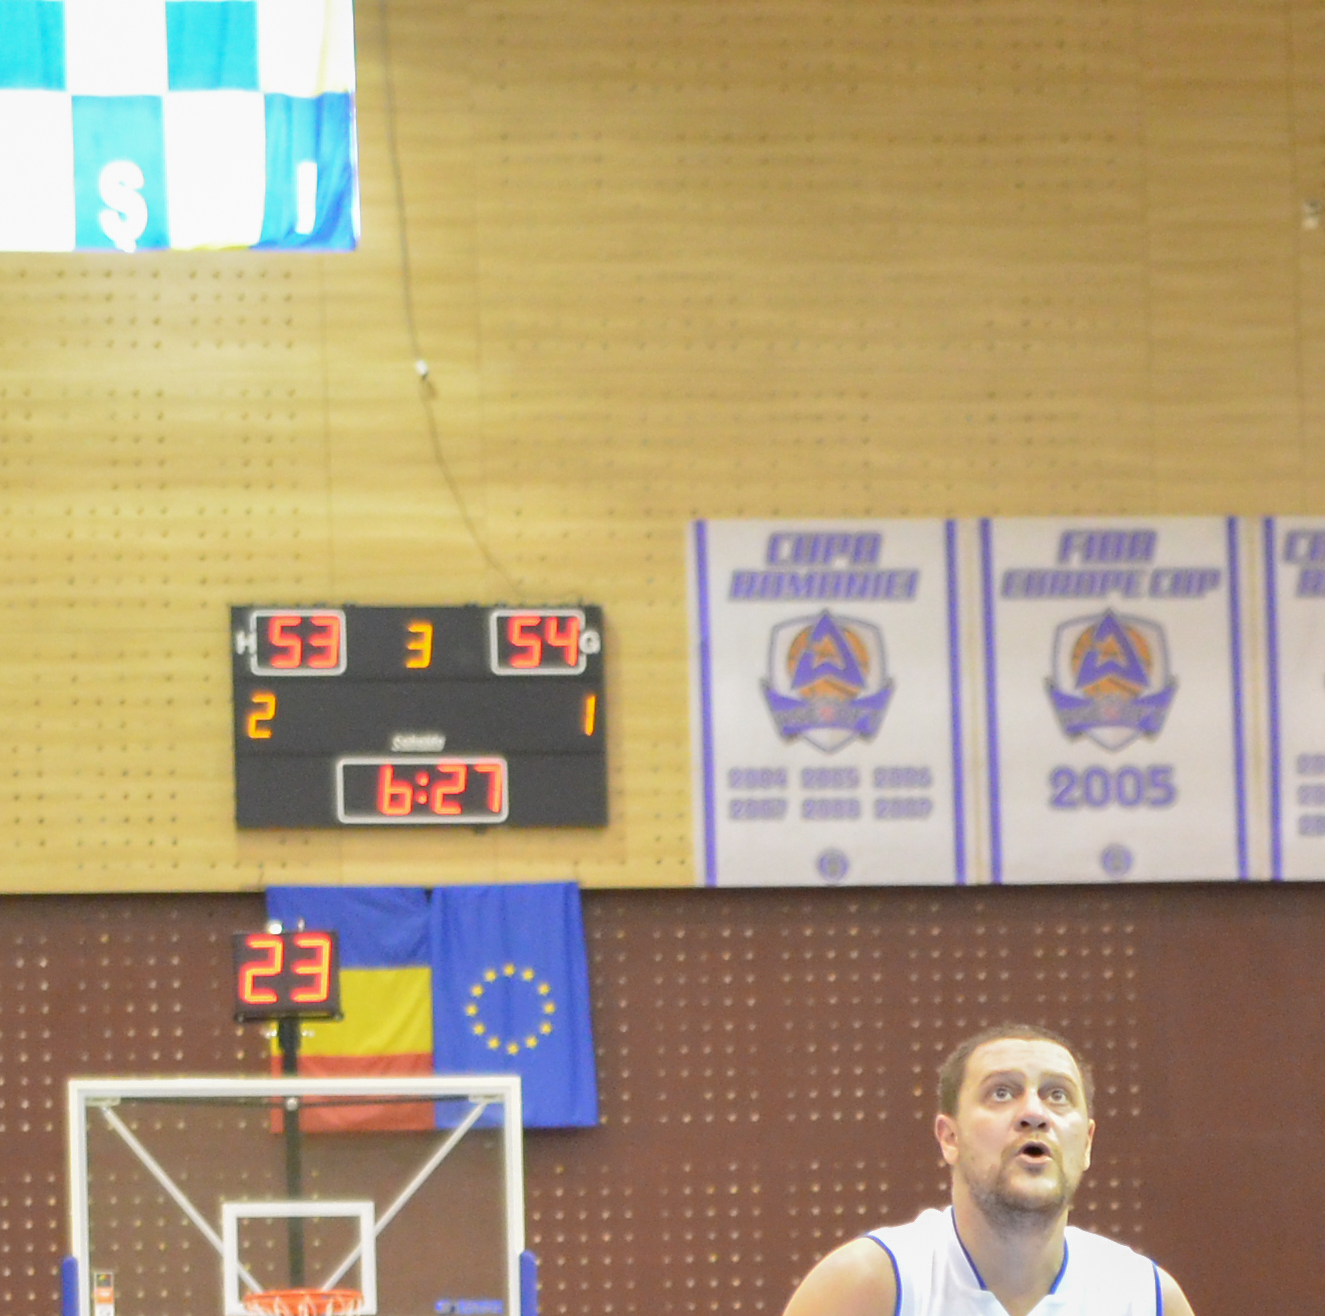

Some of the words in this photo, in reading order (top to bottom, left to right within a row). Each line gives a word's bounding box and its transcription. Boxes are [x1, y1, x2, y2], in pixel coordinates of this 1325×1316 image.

[766, 531, 882, 567] CUPA
[1001, 568, 1148, 599] EUROPE
[1149, 568, 1222, 599] CUP
[267, 615, 342, 669] 53
[405, 621, 433, 669] 3
[507, 614, 580, 669] 54
[245, 692, 277, 740] 2
[581, 693, 596, 737] 1
[377, 762, 503, 817] 6:27
[1049, 763, 1179, 809] 2005
[238, 931, 332, 1005] 23
